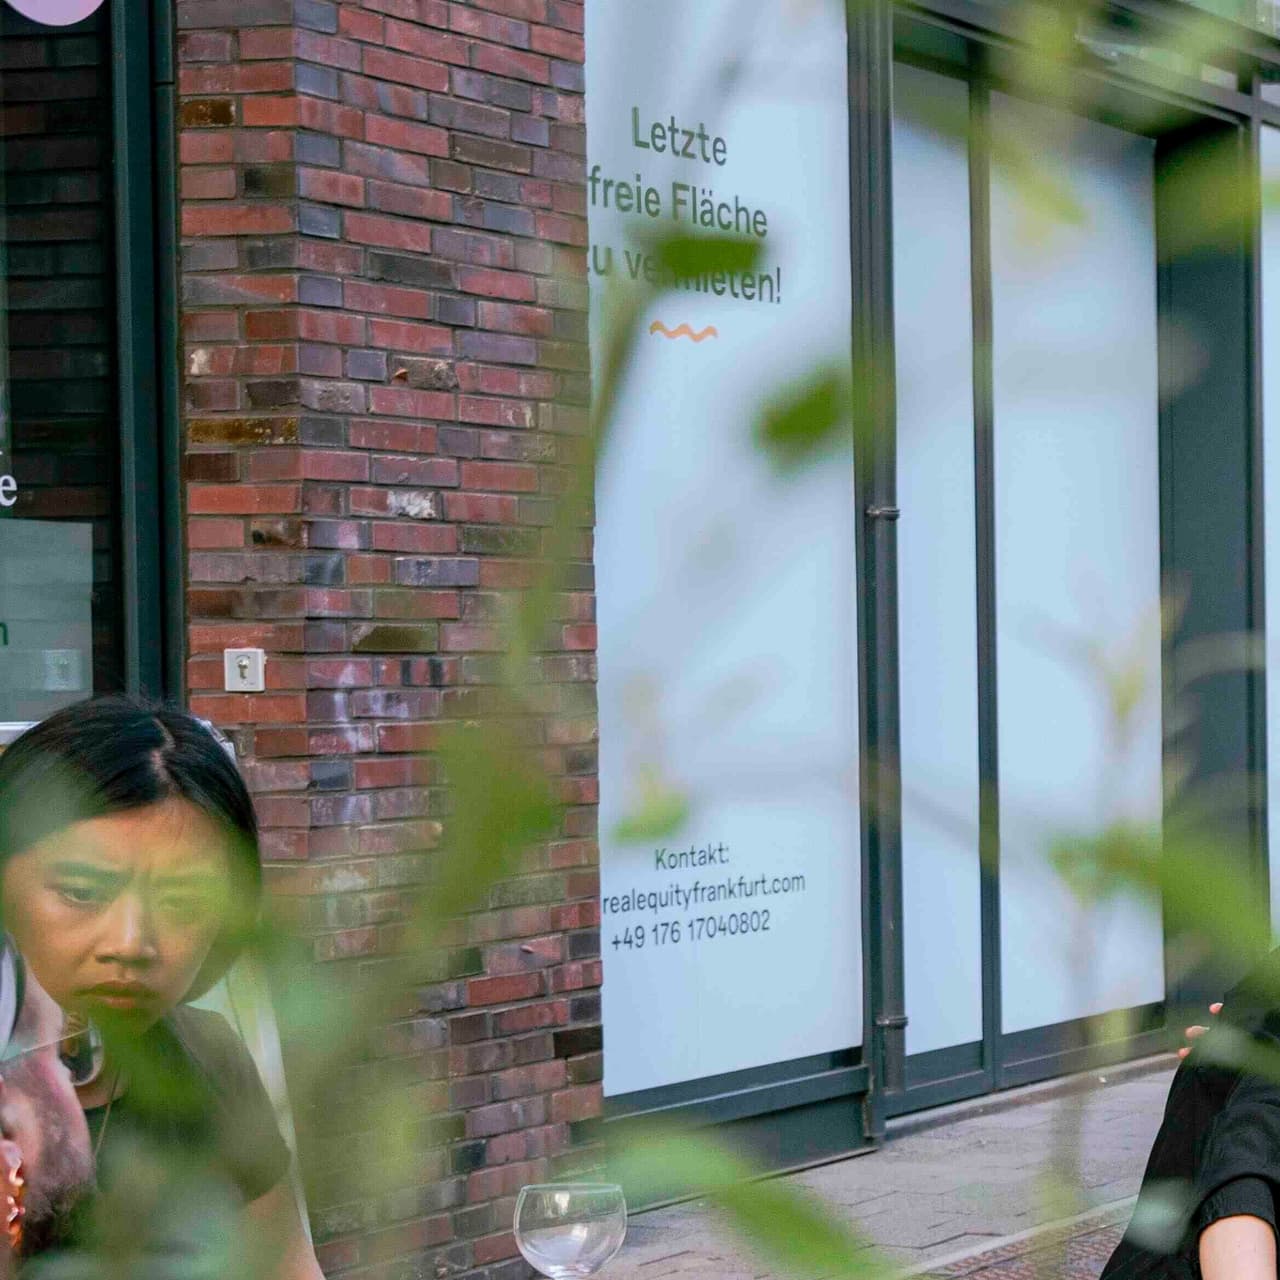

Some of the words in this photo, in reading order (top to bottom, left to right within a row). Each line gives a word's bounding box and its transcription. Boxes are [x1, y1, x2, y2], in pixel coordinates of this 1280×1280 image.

[632, 107, 727, 166] Letzte
[588, 165, 661, 217] freie
[672, 182, 768, 238] Fläche
[586, 245, 612, 277] u
[655, 843, 729, 871] Kontakt:
[603, 873, 806, 915] realequityfrankfurt.com
[611, 925, 645, 951] +49
[651, 922, 681, 946] 176
[688, 909, 770, 942] 17040802
